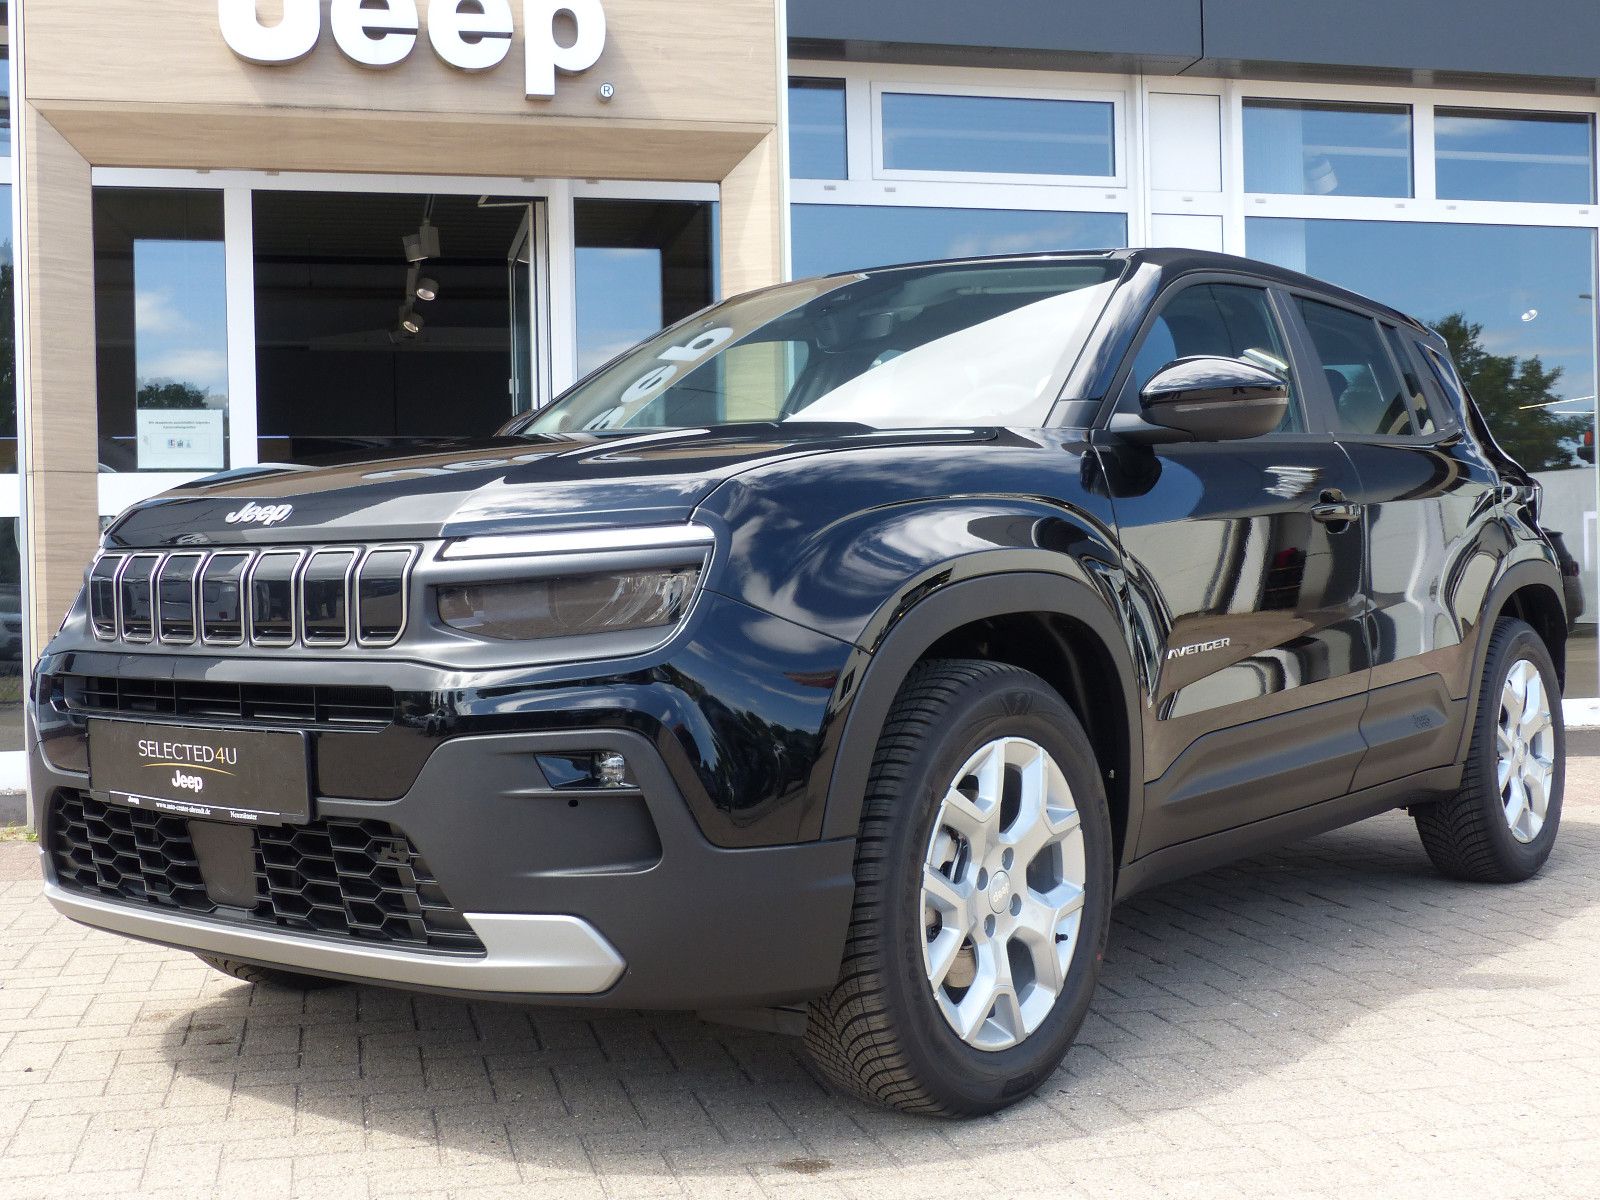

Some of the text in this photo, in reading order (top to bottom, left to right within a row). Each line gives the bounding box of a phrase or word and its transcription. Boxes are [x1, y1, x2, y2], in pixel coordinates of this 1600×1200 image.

[225, 501, 293, 526] Jeep
[1167, 637, 1231, 659] AVENGER
[138, 739, 237, 764] SELECTED4U
[171, 769, 203, 792] Jeep
